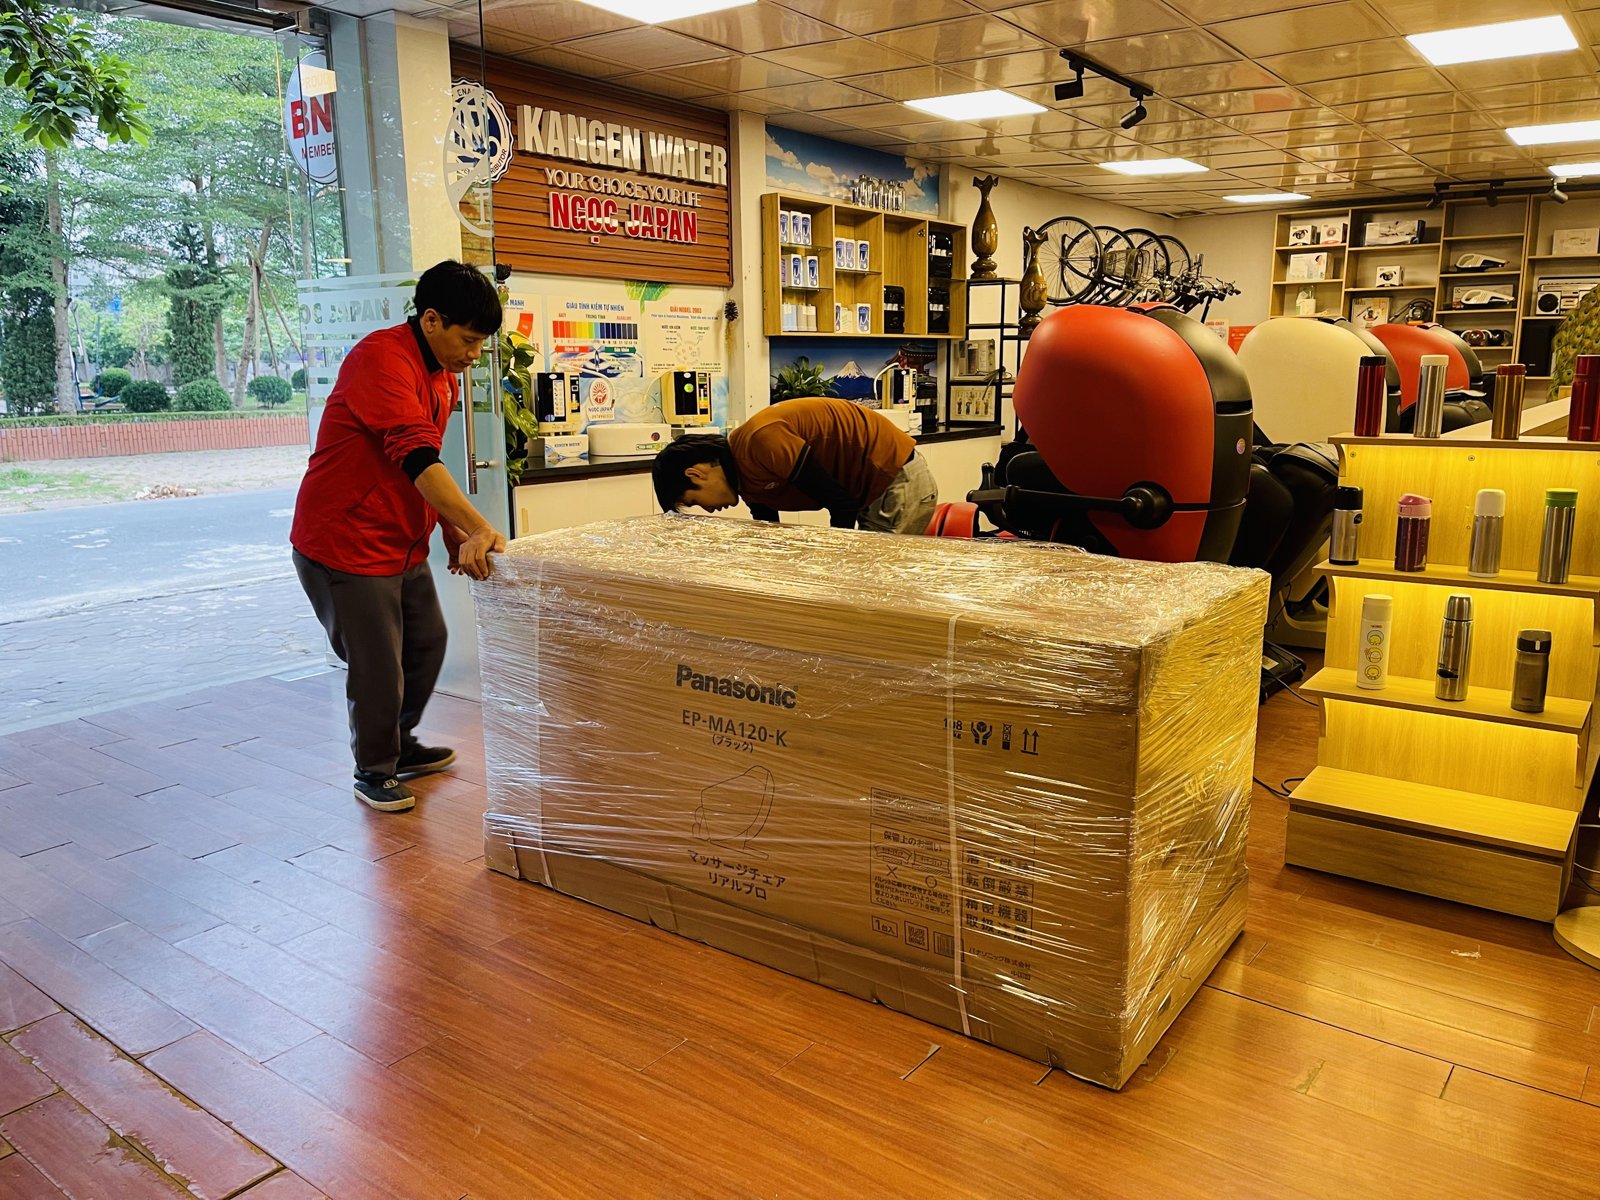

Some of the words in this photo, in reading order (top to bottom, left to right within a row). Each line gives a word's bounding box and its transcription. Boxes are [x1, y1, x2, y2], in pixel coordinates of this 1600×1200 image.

[517, 104, 641, 171] KANGEN
[645, 130, 727, 186] WATER
[544, 167, 585, 189] YOUR
[589, 174, 641, 199] CHOICE
[646, 184, 680, 203] YOUR
[682, 190, 701, 207] LIFE
[550, 191, 619, 244] NGỌC
[628, 204, 697, 244] JAPAN
[676, 664, 797, 709] Panasonic
[682, 709, 788, 748] EP-MA120-K
[687, 849, 786, 888] マッサージチェア
[708, 871, 767, 900] リアルプロ
